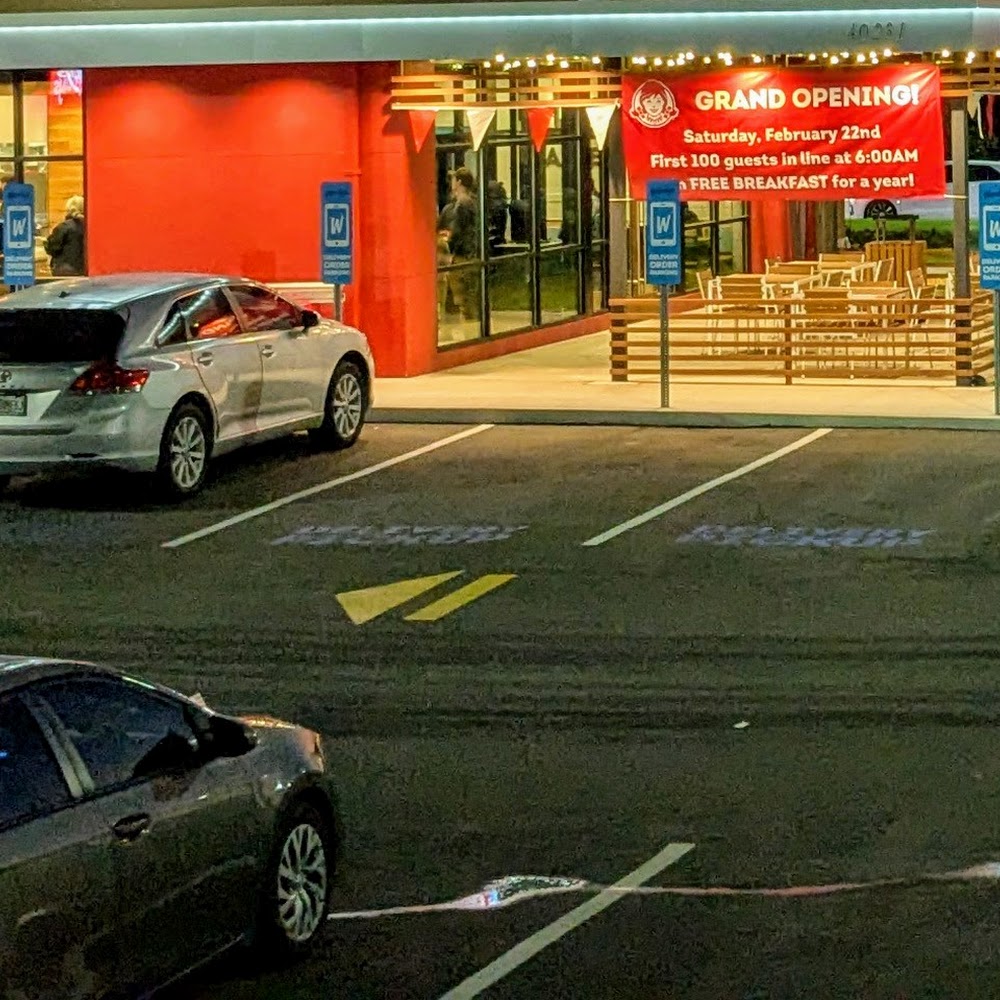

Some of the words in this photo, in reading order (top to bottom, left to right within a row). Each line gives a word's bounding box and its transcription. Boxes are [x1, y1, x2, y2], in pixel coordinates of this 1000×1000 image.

[695, 88, 786, 111] GRAND
[792, 84, 920, 108] OPENING!
[683, 128, 762, 146] Saturday,
[765, 127, 838, 145] February
[841, 125, 881, 140] 22nd
[650, 154, 688, 168] First
[691, 153, 720, 168] 100
[724, 154, 778, 171] guests
[782, 152, 797, 166] in
[800, 151, 831, 165] line
[834, 152, 852, 164] at
[855, 149, 919, 164] 6:00AM
[690, 177, 730, 190] FREE
[733, 175, 828, 190] BREAKFAST
[832, 174, 857, 188] for
[860, 178, 870, 188] a
[873, 173, 915, 191] year!
[13, 218, 27, 237] W
[331, 215, 344, 235] W
[658, 214, 671, 234] W
